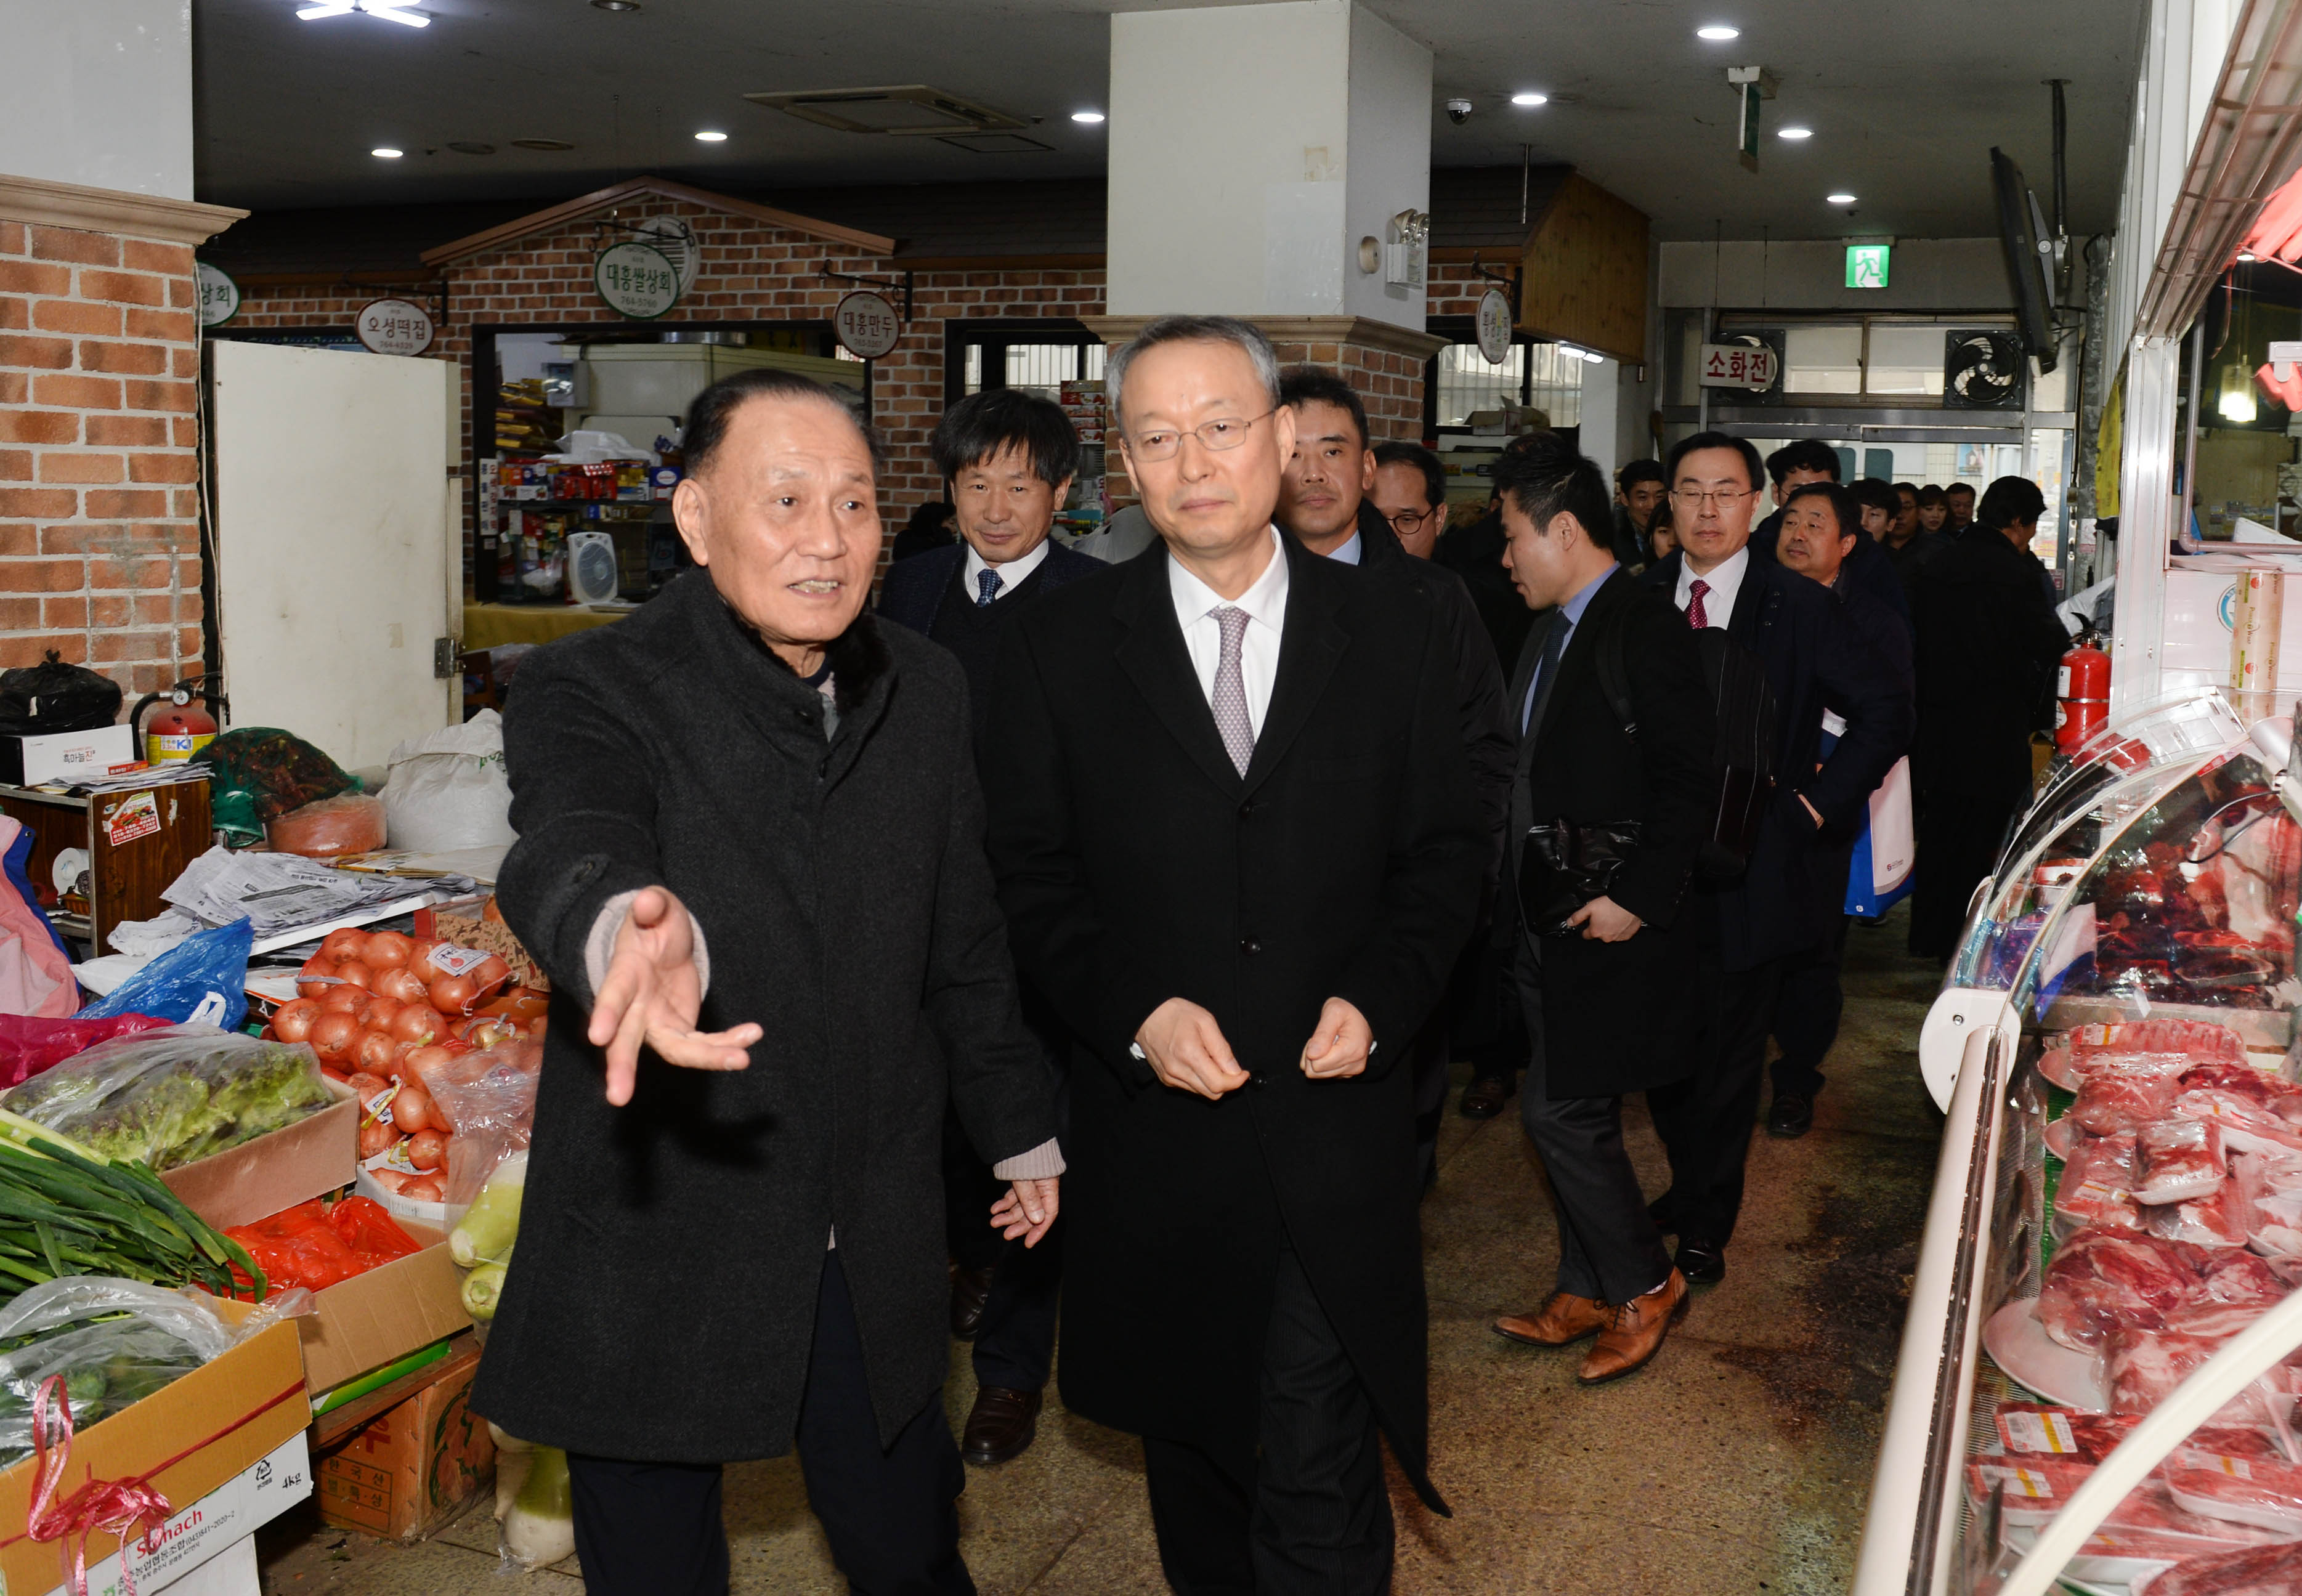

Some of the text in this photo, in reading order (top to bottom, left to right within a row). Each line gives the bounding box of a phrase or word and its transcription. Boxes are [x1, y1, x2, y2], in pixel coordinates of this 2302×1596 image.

[606, 263, 671, 296] 대흥쌀상회
[843, 311, 893, 338] 대흥만두
[1706, 350, 1767, 383] 소화전
[282, 1472, 301, 1489] 4kg
